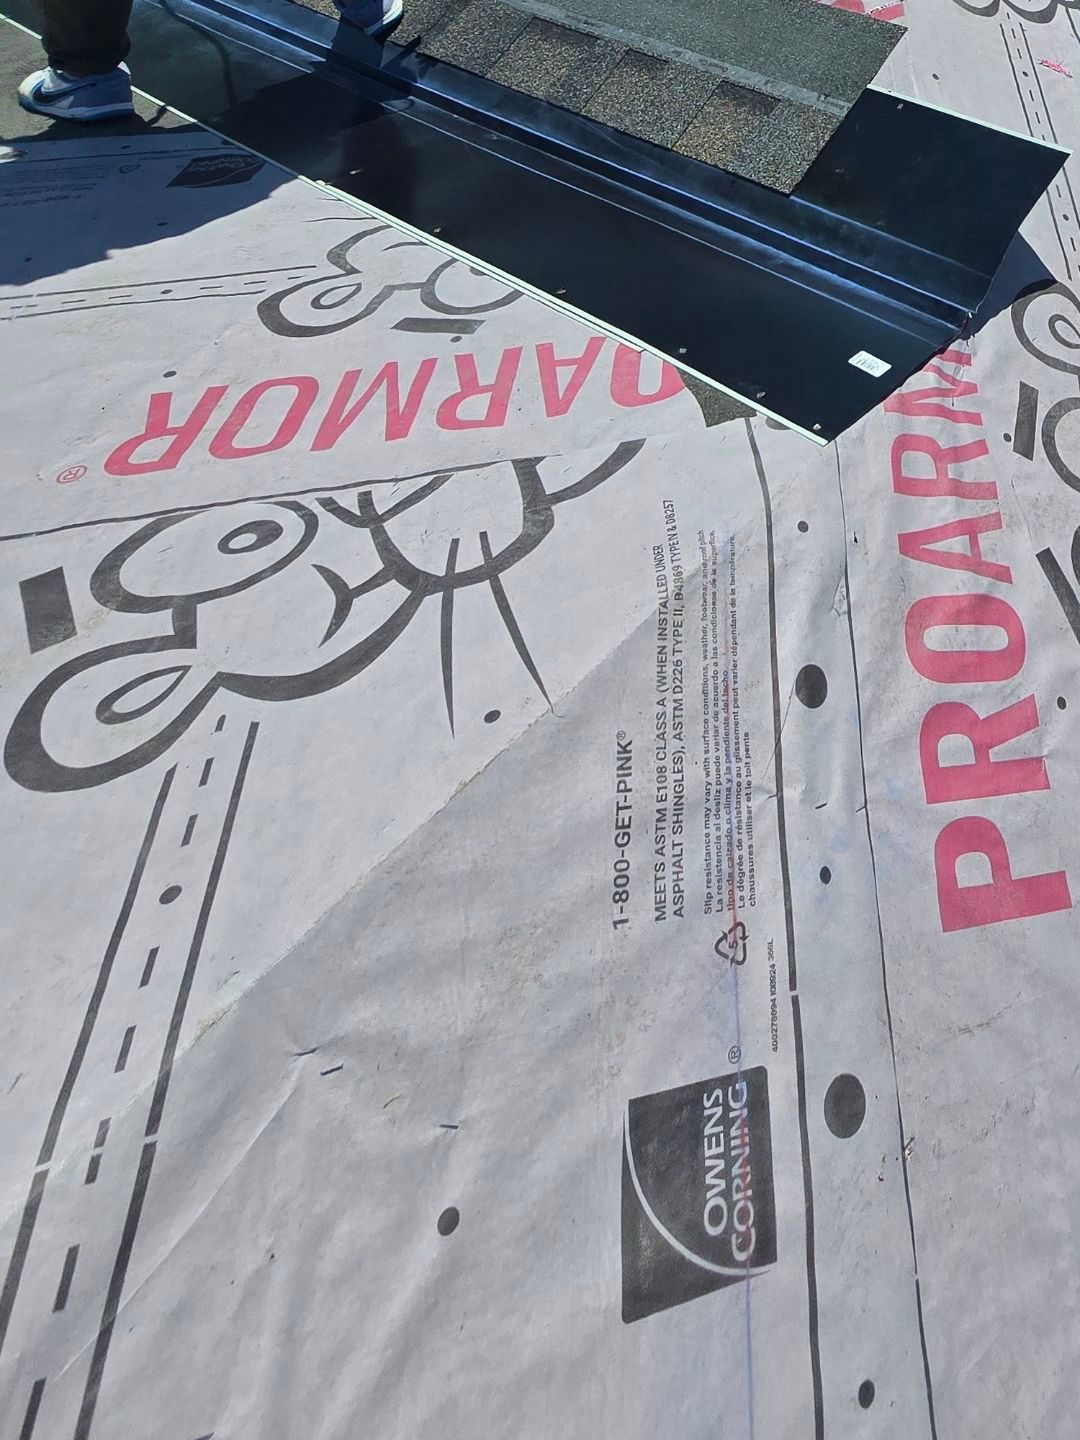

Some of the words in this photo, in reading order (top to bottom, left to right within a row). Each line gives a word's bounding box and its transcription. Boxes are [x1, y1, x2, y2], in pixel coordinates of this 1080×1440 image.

[662, 499, 677, 524] D8257
[652, 543, 665, 571] UNDER
[671, 541, 681, 562] TYPE
[655, 574, 668, 640] INSTALLED
[672, 620, 683, 654] TYPE
[709, 646, 717, 659] las
[655, 645, 669, 692] (WHEN
[671, 659, 683, 694] D226
[656, 697, 666, 707] A
[709, 668, 718, 707] acuerdo
[731, 686, 740, 708] peut
[671, 698, 683, 741] ASTM
[711, 710, 719, 722] de
[654, 711, 667, 761] CLASS
[701, 718, 710, 754] surface
[712, 724, 720, 752] variar
[722, 715, 731, 763] pendiente
[731, 710, 742, 763] glissement
[742, 731, 753, 758] pente
[702, 757, 710, 777] with
[713, 755, 721, 785] puede
[734, 765, 741, 778] au
[656, 765, 667, 803] E108
[671, 745, 685, 835] SHINGLES),
[703, 781, 712, 803] vary
[723, 786, 732, 815] clima
[703, 806, 711, 828] may
[712, 787, 721, 820] desliz
[653, 807, 666, 857] ASTM
[713, 822, 721, 832] al
[744, 804, 754, 840] utiliser
[703, 832, 711, 888] resistance
[724, 826, 733, 869] calzado
[735, 837, 743, 850] de
[672, 840, 684, 918] ASPHALT
[714, 834, 723, 895] resistencia
[726, 871, 733, 885] de
[746, 843, 757, 906] chaussures
[654, 861, 665, 921] MEETS
[703, 892, 713, 914] Slip
[715, 898, 723, 912] La
[737, 894, 745, 908] Le
[702, 1088, 727, 1236] OWENS
[727, 1080, 755, 1261] CORNING
